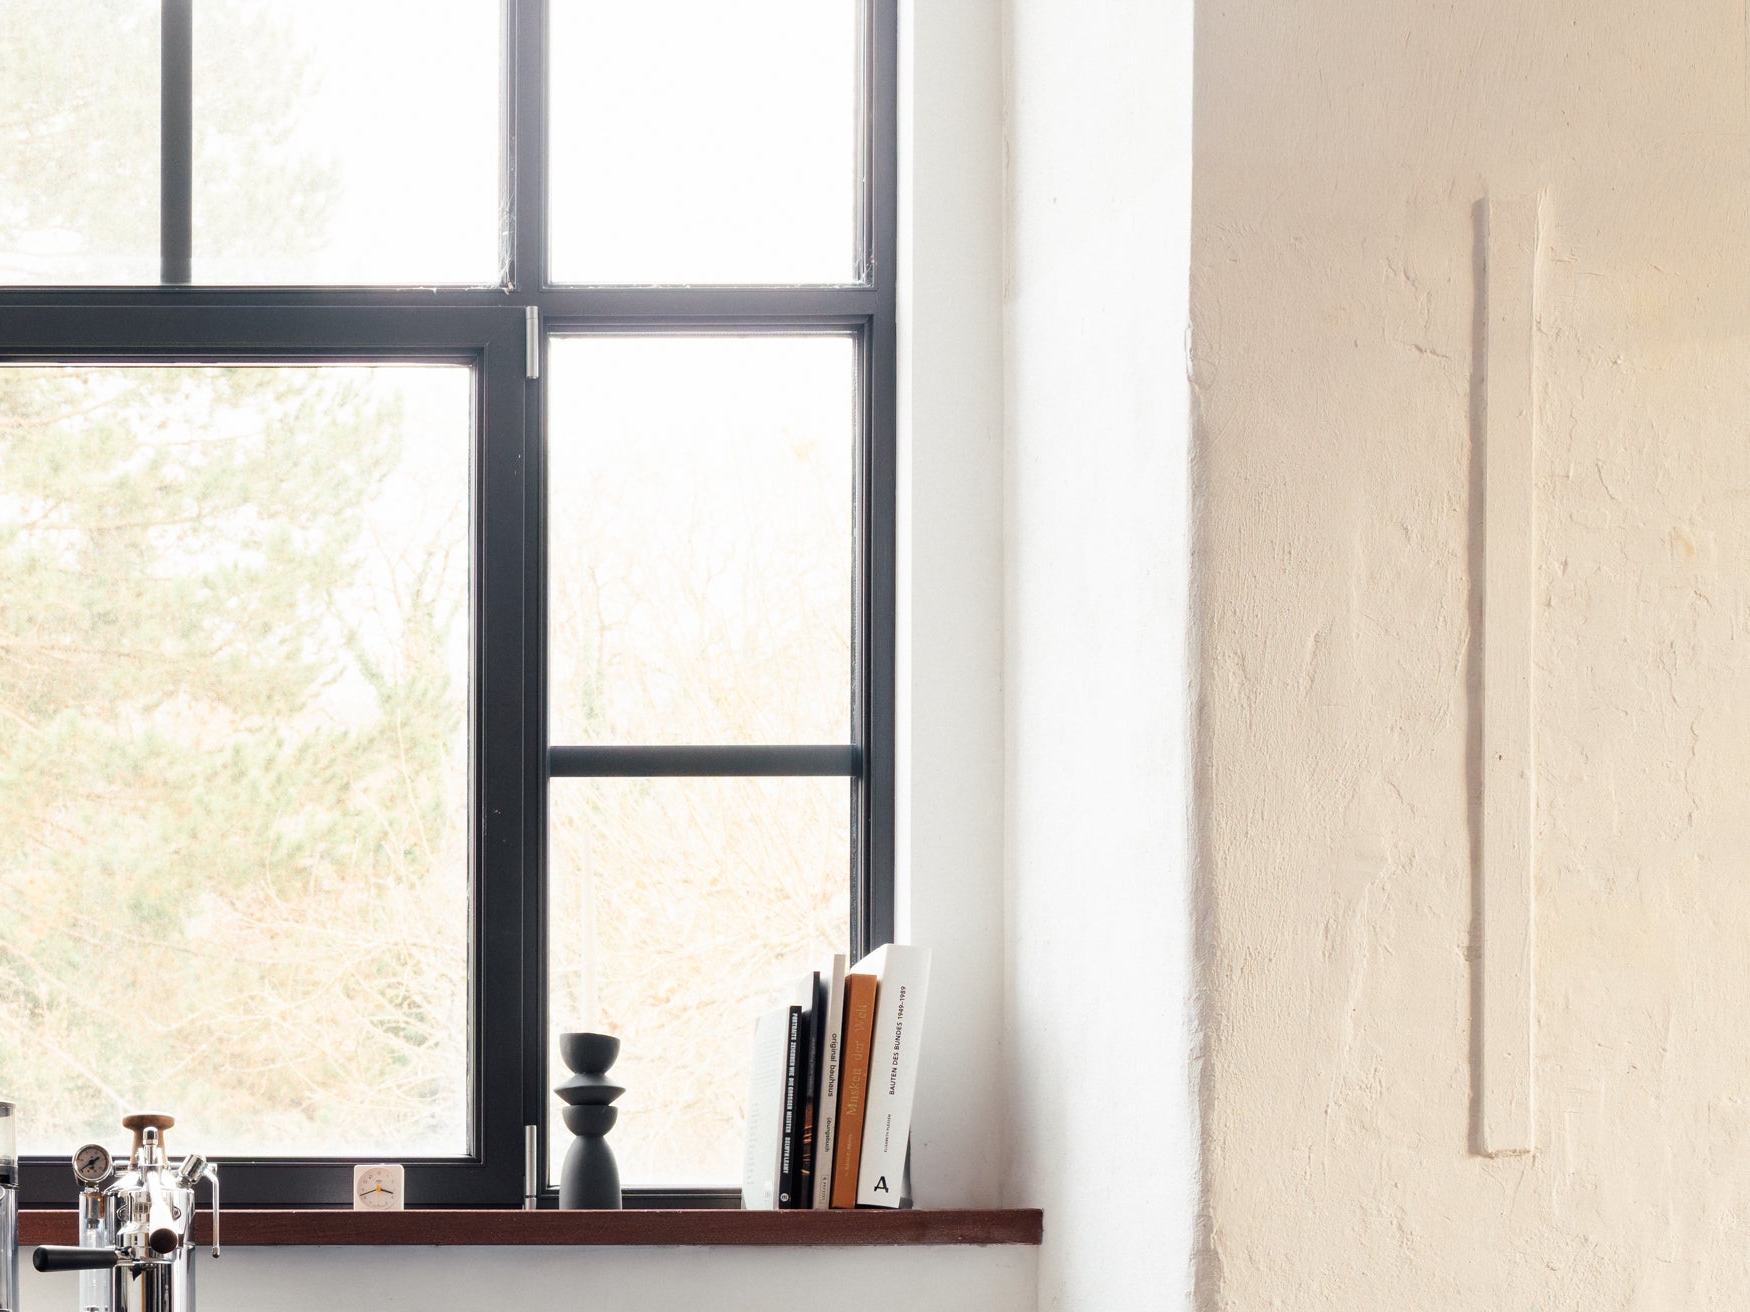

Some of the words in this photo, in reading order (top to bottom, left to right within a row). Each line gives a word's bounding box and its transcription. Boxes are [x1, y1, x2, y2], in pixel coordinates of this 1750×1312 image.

[790, 1012, 798, 1041] PORTRAITS
[855, 1003, 869, 1032] Welt
[829, 1033, 837, 1062] original
[894, 1021, 903, 1050] BUNDES
[853, 1040, 865, 1062] der
[892, 1050, 900, 1065] DES
[846, 1068, 862, 1116] Masken
[889, 1066, 898, 1095] BAUTEN
[786, 1086, 794, 1110] GROSSEN
[785, 1111, 793, 1133] MEISTER
[824, 1117, 832, 1153] übungsbuch
